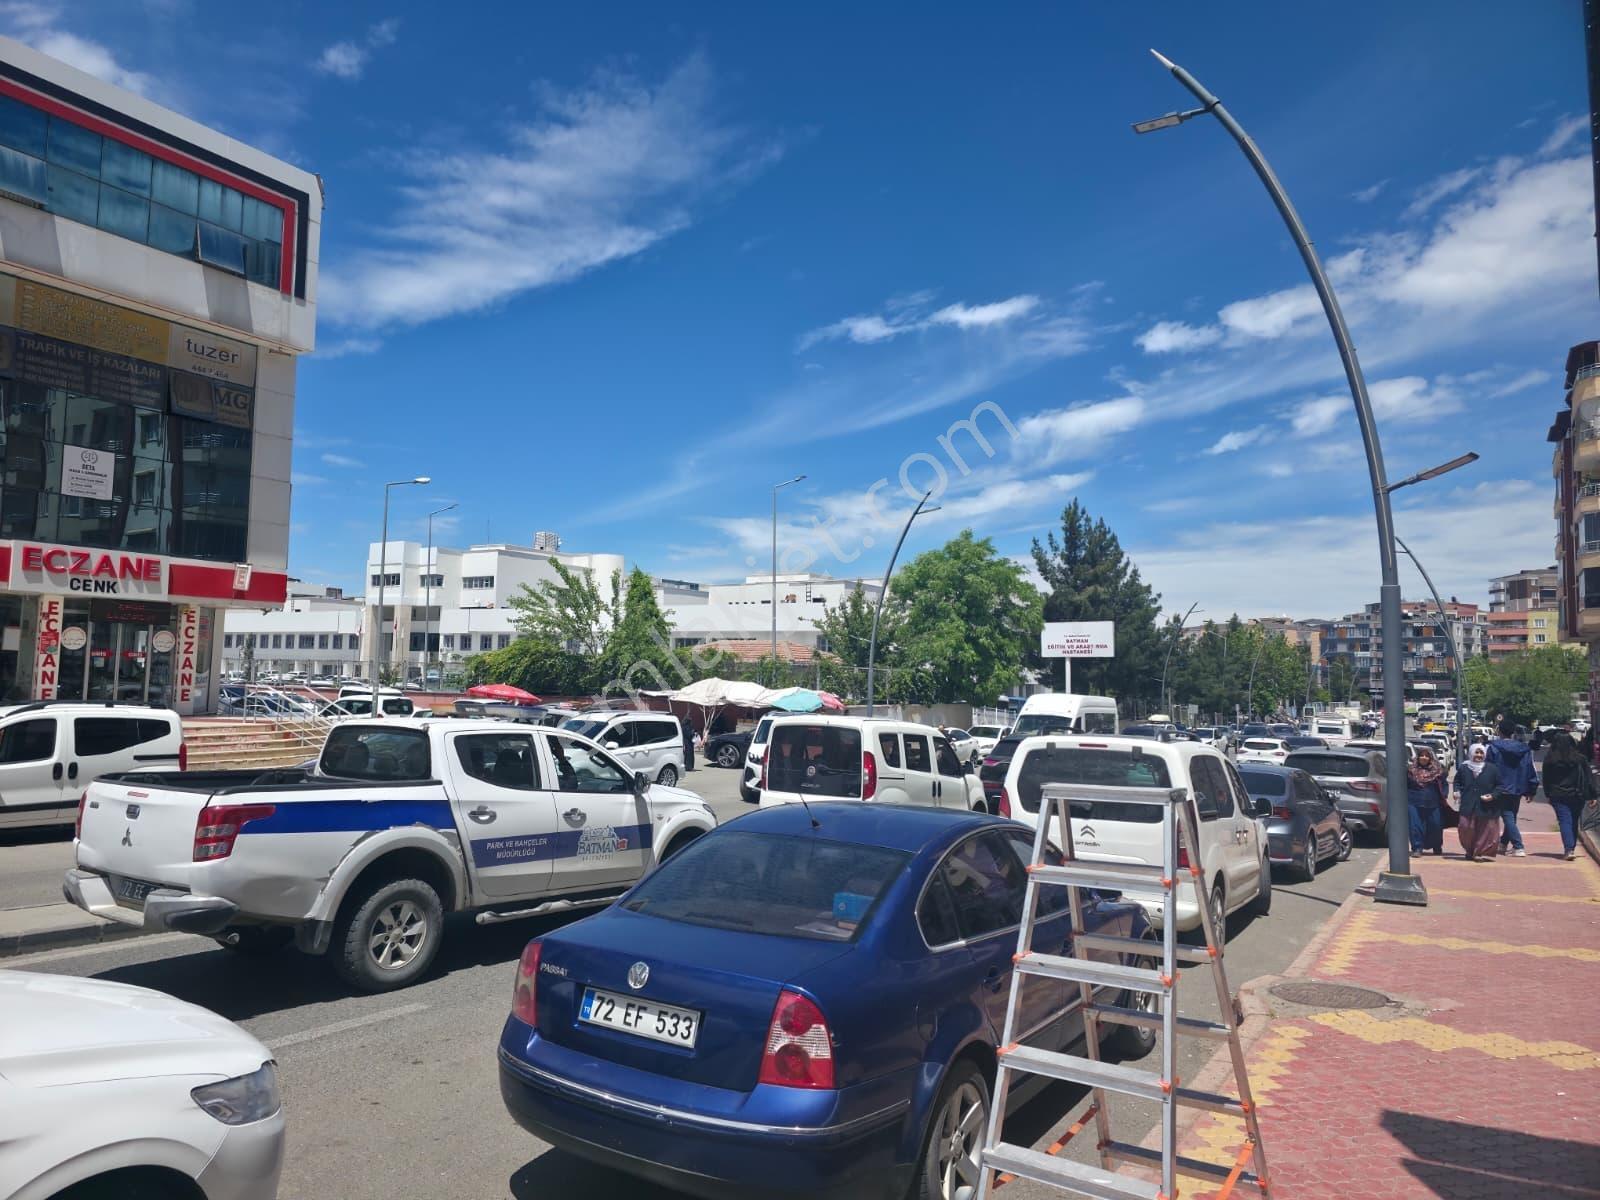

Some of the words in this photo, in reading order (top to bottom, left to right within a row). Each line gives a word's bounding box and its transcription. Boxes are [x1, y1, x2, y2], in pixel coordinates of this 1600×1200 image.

[22, 546, 161, 581] ECZANE
[69, 577, 118, 594] CENK
[41, 601, 59, 700] ECANE
[181, 610, 196, 702] ECZANE
[487, 841, 504, 850] PARK
[505, 840, 513, 848] VE
[540, 962, 568, 977] PASSAT
[593, 996, 616, 1022] 72
[622, 1002, 648, 1028] EF
[655, 1010, 694, 1040] 533
